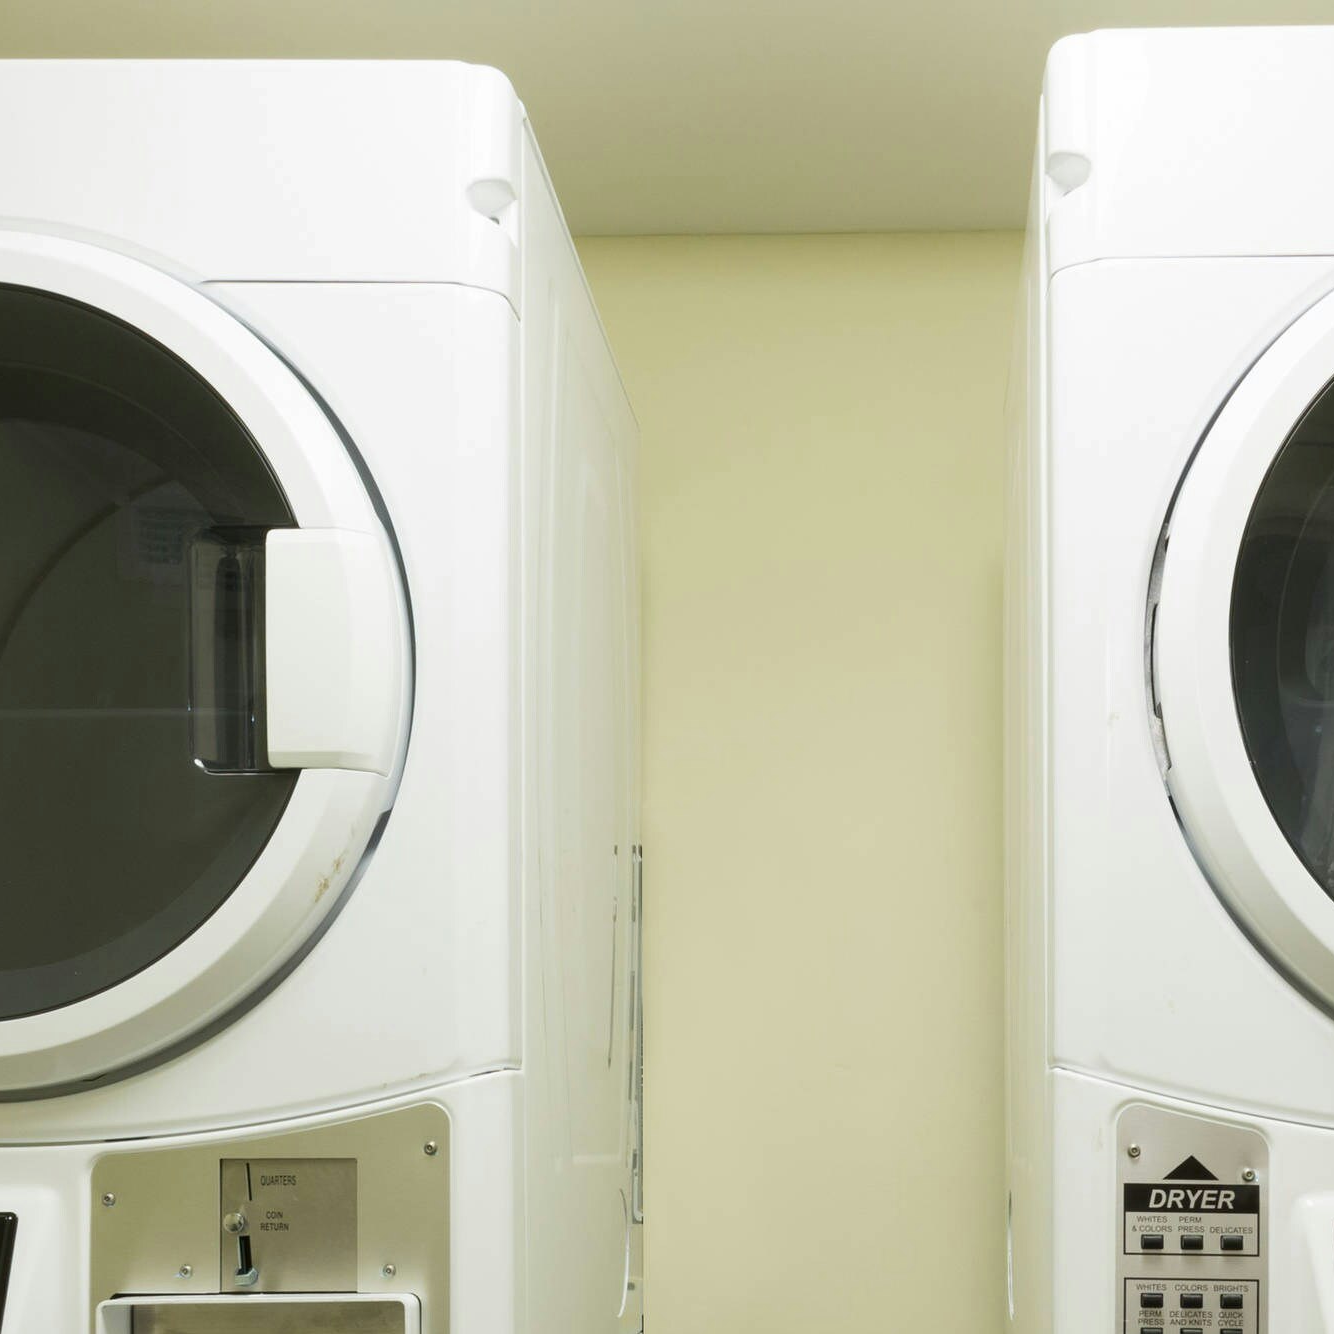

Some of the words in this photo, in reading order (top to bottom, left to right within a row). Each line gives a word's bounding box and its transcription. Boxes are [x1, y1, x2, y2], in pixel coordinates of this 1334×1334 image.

[261, 1176, 296, 1186] QUARTERS
[1149, 1189, 1235, 1209] DRYER
[267, 1211, 283, 1219] COIN
[260, 1223, 289, 1231] RETURN
[1219, 1311, 1243, 1319] QUICK
